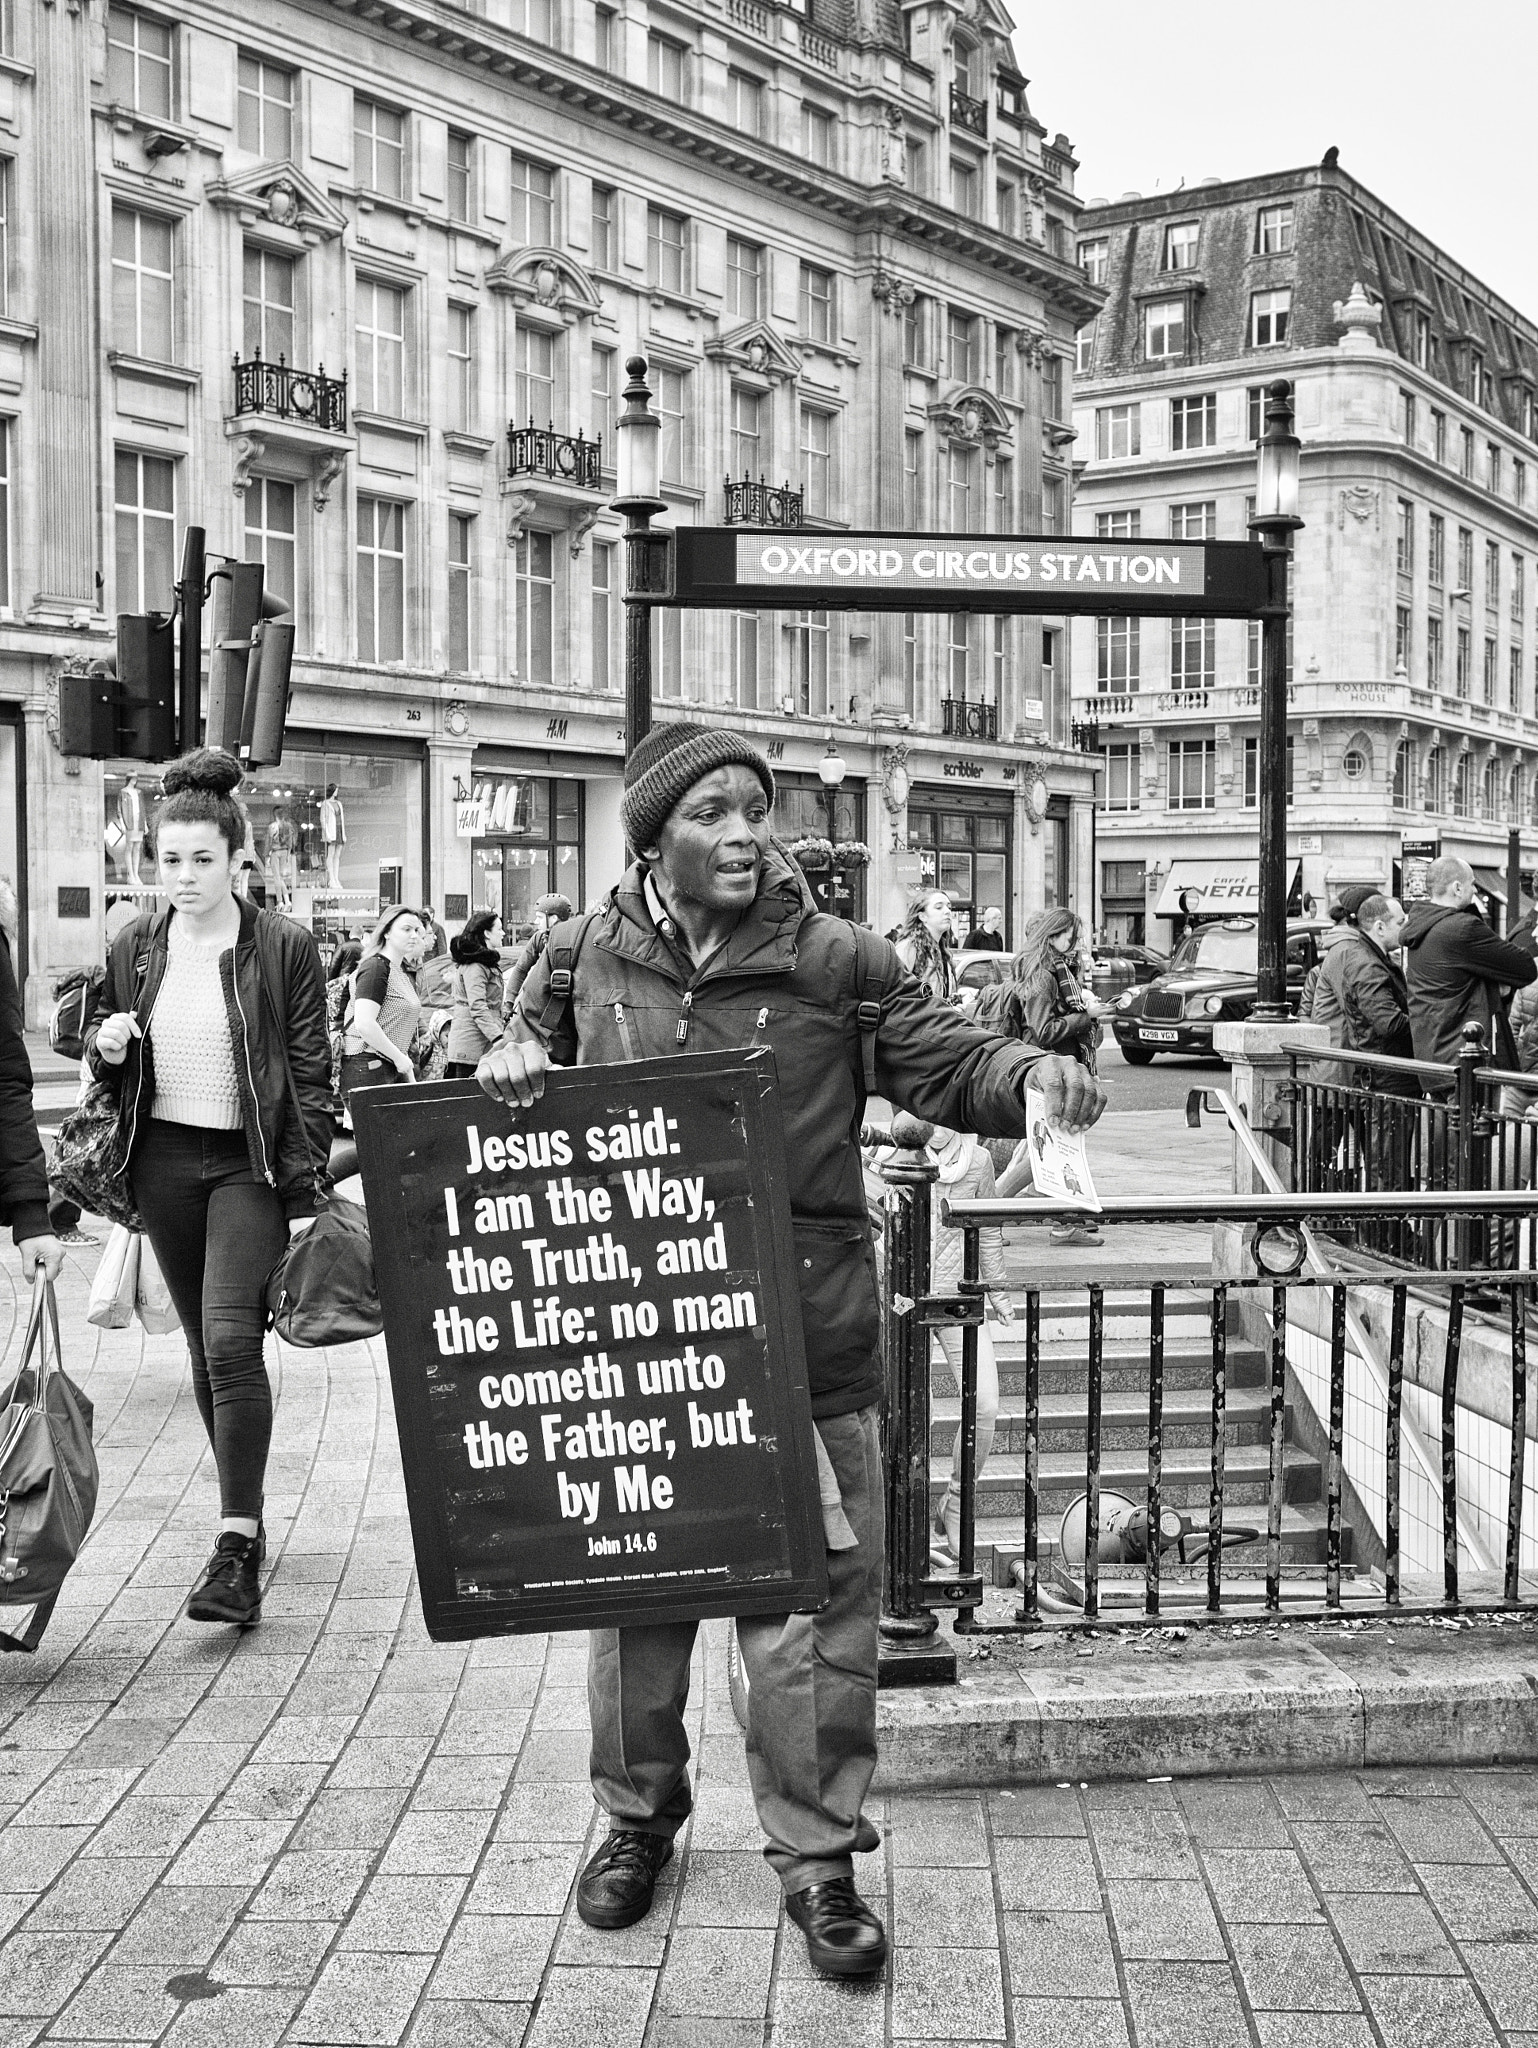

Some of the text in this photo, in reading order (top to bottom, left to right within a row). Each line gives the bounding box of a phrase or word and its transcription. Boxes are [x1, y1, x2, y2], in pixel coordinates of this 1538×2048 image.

[760, 545, 1181, 584] OXFORD CIRCUS STATION
[1351, 693, 1386, 702] HOUSE
[406, 710, 421, 721] 263
[546, 718, 568, 740] H&M
[766, 741, 784, 760] H&M
[943, 761, 984, 778] scribbler
[1003, 767, 1016, 780] 269
[458, 809, 480, 830] H&M
[1213, 876, 1248, 884] CAFFÉ
[1141, 1029, 1175, 1040] W298 VGX
[467, 1107, 680, 1173] Jesus said:
[445, 1168, 714, 1236] I am the Way,
[446, 1222, 727, 1294] the Truth, and
[433, 1292, 756, 1355] the Life: no man
[479, 1346, 725, 1408] cometh unto
[463, 1399, 756, 1468] the Father, but
[557, 1465, 673, 1524] by Me
[588, 1532, 656, 1556] John 14.6
